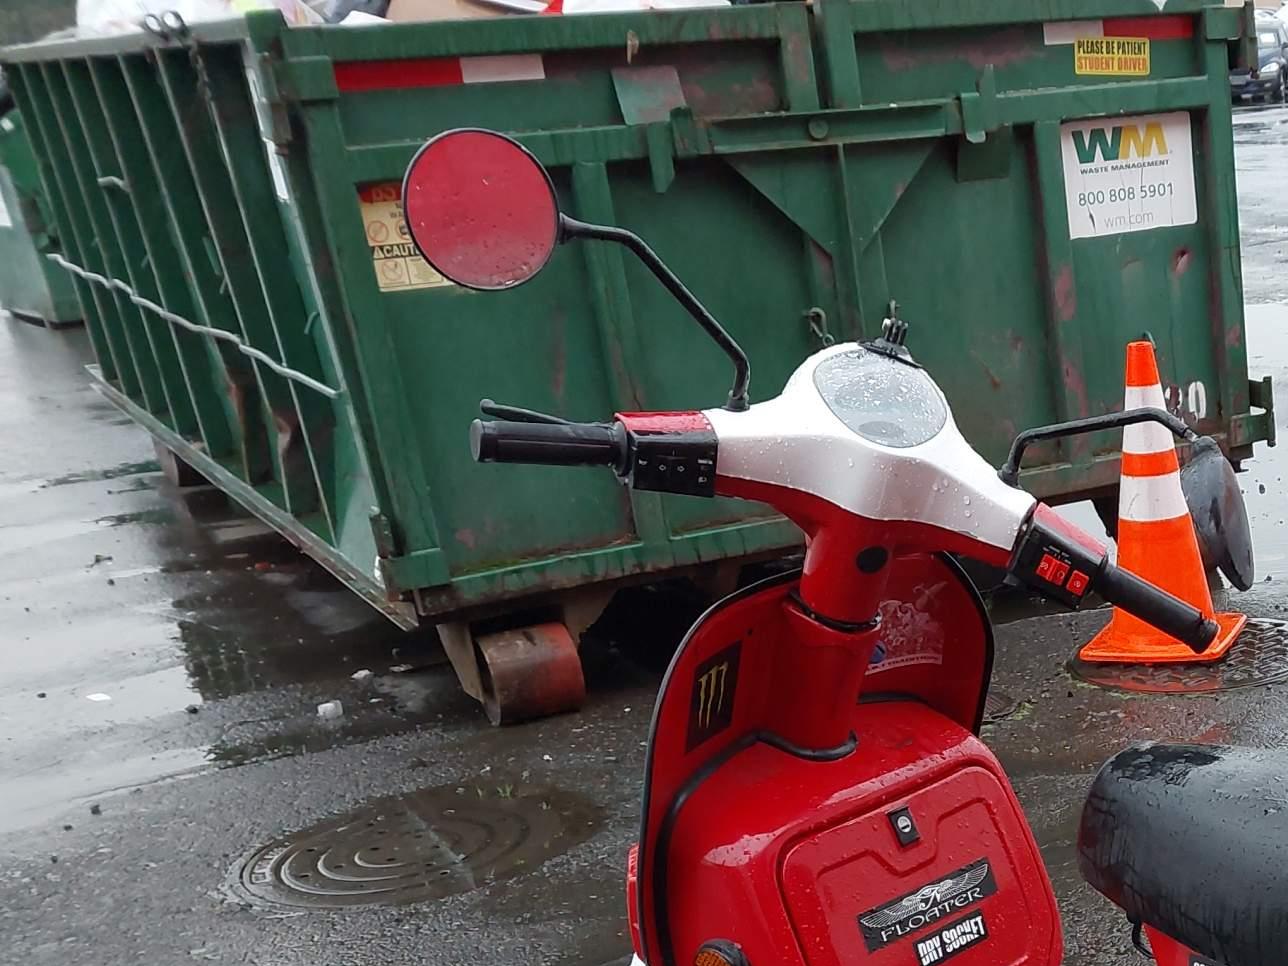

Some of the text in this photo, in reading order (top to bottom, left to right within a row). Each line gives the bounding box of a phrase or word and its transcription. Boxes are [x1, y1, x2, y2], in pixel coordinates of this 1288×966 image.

[1077, 40, 1146, 55] PLEASE BE PATIENT
[1077, 55, 1147, 71] STUDENT DRIVER
[1071, 122, 1169, 164] WM
[1080, 159, 1169, 175] WASTE MANAGEMENT
[1078, 182, 1174, 206] 800 808 5901
[383, 244, 421, 257] CAUT
[880, 887, 984, 942] FLOATER
[917, 915, 985, 966] DRY SOCKET
